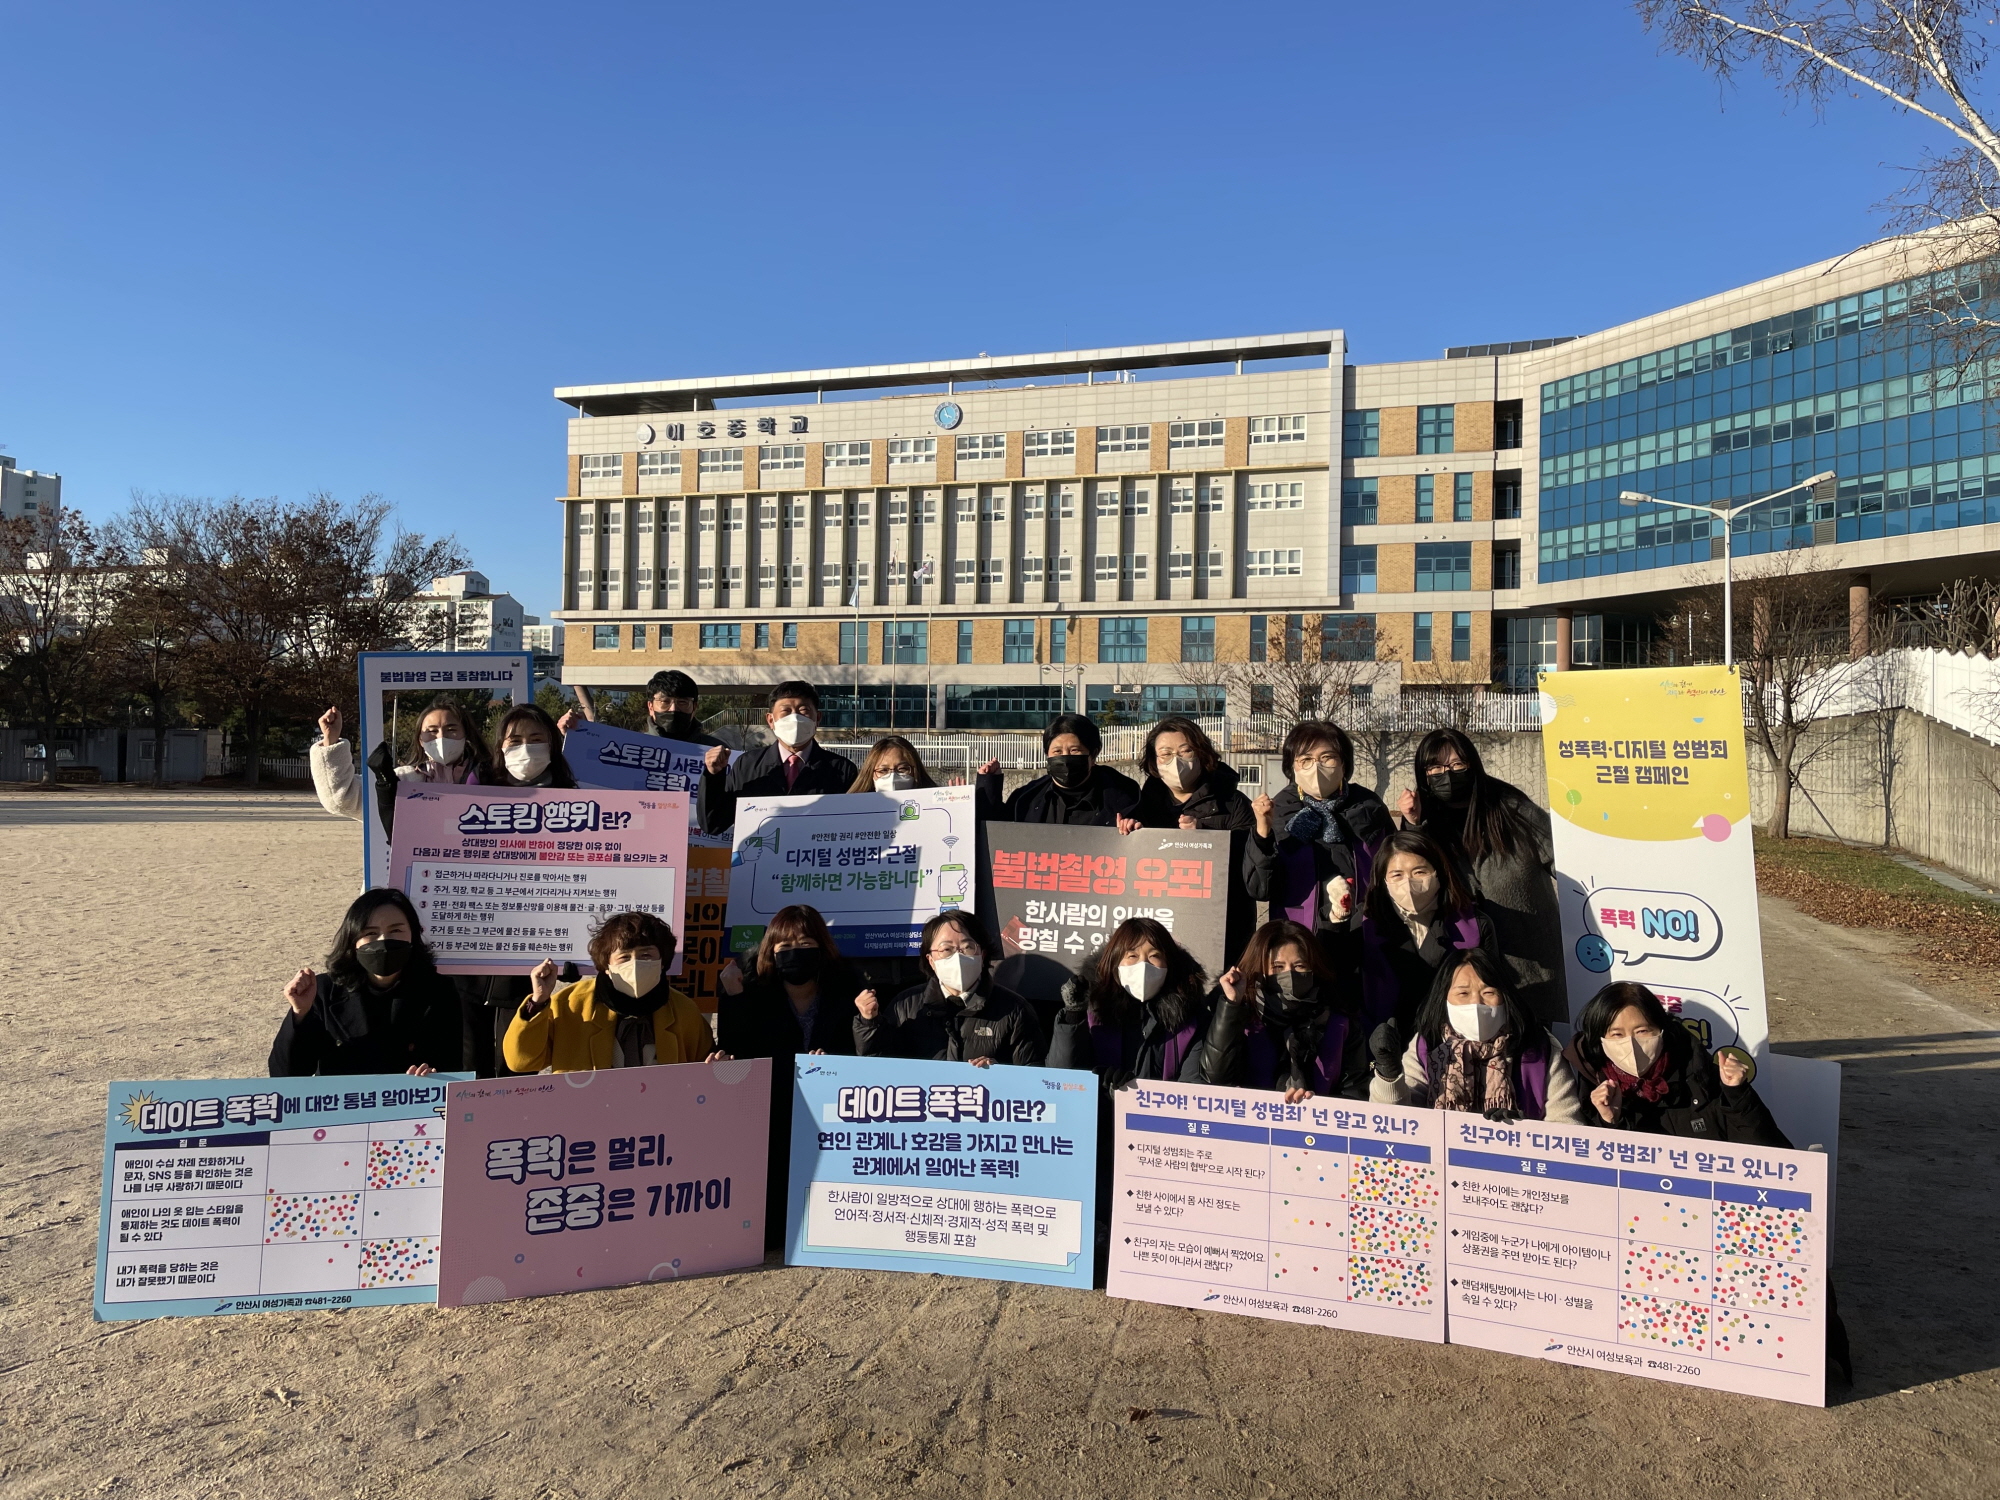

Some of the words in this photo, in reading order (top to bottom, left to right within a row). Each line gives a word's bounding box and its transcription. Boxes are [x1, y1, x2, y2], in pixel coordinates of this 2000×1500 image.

[666, 416, 809, 441] 이호중학교
[380, 671, 426, 682] 불법촬영
[430, 670, 453, 682] 근절
[456, 670, 513, 681] 동참합니다
[599, 740, 670, 771] 스토킹!
[1558, 740, 1666, 759] 성폭력·디지털
[1672, 740, 1728, 760] 성범죄
[1596, 766, 1630, 784] 근절
[1634, 766, 1690, 785] 캠페인
[458, 802, 542, 834] 스토킹
[461, 837, 497, 847] 상대방의
[499, 839, 526, 848] 의사에
[528, 840, 554, 849] 반하여
[557, 840, 583, 850] 정당한
[585, 841, 602, 850] 이유
[604, 841, 621, 851] 없이
[811, 832, 837, 841] #안전할
[838, 831, 853, 841] 권리
[854, 830, 881, 840] #안전한
[882, 829, 897, 840] 일상
[412, 847, 440, 857] 다음과
[442, 848, 460, 858] 같은
[463, 849, 489, 858] 행위로
[492, 850, 536, 860] 상대방에게
[538, 851, 565, 861] 불안감
[566, 852, 584, 861] 또는
[586, 852, 620, 862] 공포심을
[623, 853, 657, 862] 일으키는
[659, 853, 667, 862] 것
[786, 848, 832, 868] 디지털
[836, 846, 882, 866] 성범죄
[886, 844, 917, 864] 근절
[435, 870, 472, 879] 접근하거나
[474, 871, 518, 880] 따라다니거나
[519, 872, 540, 881] 따라다니거나
[542, 873, 570, 882] 진로를
[573, 874, 587, 882] 행위
[992, 850, 1126, 896] 불법촬영
[1134, 858, 1213, 898] 유포!
[1026, 900, 1107, 928] 한사람의
[1600, 908, 1636, 930] 폭력
[1642, 908, 1700, 942] NO!
[1018, 928, 1058, 952] 망칠
[1064, 931, 1084, 954] 수
[140, 1098, 224, 1134] 데이트
[305, 1093, 339, 1112] 대한
[343, 1091, 376, 1109] 통념
[381, 1086, 447, 1107] 알아보기
[838, 1085, 927, 1123] 데이트
[1135, 1088, 1187, 1110] 친구야!
[1312, 1107, 1327, 1126] 넌
[1333, 1109, 1367, 1129] 알고
[1372, 1114, 1418, 1135] 있니?
[816, 1132, 851, 1151] 연인
[855, 1131, 907, 1150] 관계나
[911, 1132, 961, 1151] 호감을
[966, 1133, 1017, 1153] 가지고
[1022, 1135, 1073, 1155] 만나는
[1137, 1143, 1160, 1155] 디지털
[1162, 1146, 1194, 1158] 성범죄는
[1196, 1149, 1212, 1159] 주로
[1460, 1123, 1520, 1147] 친구야!
[1669, 1149, 1687, 1169] 넌
[1694, 1152, 1735, 1173] 알고
[1741, 1157, 1797, 1180] 있니?
[124, 1159, 153, 1169] 애인이
[155, 1158, 174, 1168] 수십
[176, 1157, 195, 1167] 차례
[198, 1155, 244, 1166] 전화하거나
[486, 1134, 596, 1184] 폭력은
[608, 1134, 673, 1171] 멀리,
[852, 1156, 919, 1175] 관계에서
[924, 1157, 976, 1177] 일어난
[980, 1158, 1019, 1178] 폭력!
[1163, 1159, 1188, 1171] 사람의
[1225, 1166, 1243, 1177] 시작
[1244, 1168, 1265, 1179] 된다?
[123, 1171, 145, 1181] 문자,
[147, 1170, 171, 1180] SNS
[173, 1169, 192, 1179] 등을
[195, 1168, 231, 1178] 확인하는
[234, 1167, 252, 1177] 것은
[123, 1183, 141, 1193] 나를
[144, 1182, 163, 1192] 너무
[165, 1181, 203, 1191] 사랑하기
[205, 1179, 243, 1189] 때문이다
[1461, 1180, 1480, 1192] 친한
[1482, 1183, 1519, 1197] 사이에는
[1521, 1189, 1569, 1204] 개인정보를
[526, 1182, 634, 1235] 존중은
[646, 1177, 731, 1216] 가까이
[828, 1190, 872, 1204] 한사람이
[876, 1193, 932, 1208] 일방적으로
[936, 1197, 970, 1211] 상대에
[973, 1199, 1007, 1214] 행하는
[1010, 1202, 1056, 1219] 폭력으로
[1135, 1189, 1152, 1200] 친한
[1153, 1191, 1185, 1204] 사이에서
[1187, 1195, 1195, 1205] 몸
[1197, 1197, 1213, 1208] 사진
[1215, 1199, 1240, 1211] 정도는
[1135, 1202, 1151, 1213] 보낼
[1153, 1204, 1161, 1214] 수
[1163, 1205, 1183, 1217] 있다?
[1462, 1194, 1508, 1209] 보내주어도
[1510, 1200, 1543, 1214] 괜찮다?
[121, 1208, 149, 1218] 애인이
[152, 1207, 170, 1217] 나의
[185, 1205, 204, 1216] 입는
[206, 1204, 243, 1214] 스타일을
[120, 1219, 158, 1230] 통제하는
[160, 1218, 179, 1228] 것도
[181, 1217, 209, 1227] 데이트
[212, 1216, 240, 1226] 폭력이
[1011, 1220, 1033, 1235] 폭력
[1037, 1223, 1048, 1236] 및
[131, 1232, 141, 1242] 수
[143, 1231, 162, 1241] 있다
[905, 1229, 950, 1245] 행동통제
[953, 1233, 976, 1247] 포함
[1461, 1229, 1498, 1244] 게임중에
[1500, 1234, 1529, 1248] 누군가
[1531, 1239, 1559, 1253] 나에게
[1561, 1244, 1611, 1261] 아이템이나
[1461, 1243, 1499, 1258] 상품권을
[1500, 1248, 1519, 1261] 주면
[1522, 1252, 1550, 1265] 받아도
[1552, 1257, 1577, 1269] 된다?
[235, 1299, 260, 1309] 안산시
[262, 1297, 302, 1308] 여성가족과
[1223, 1294, 1246, 1306] 안산시
[1248, 1298, 1288, 1312] 여성보육과
